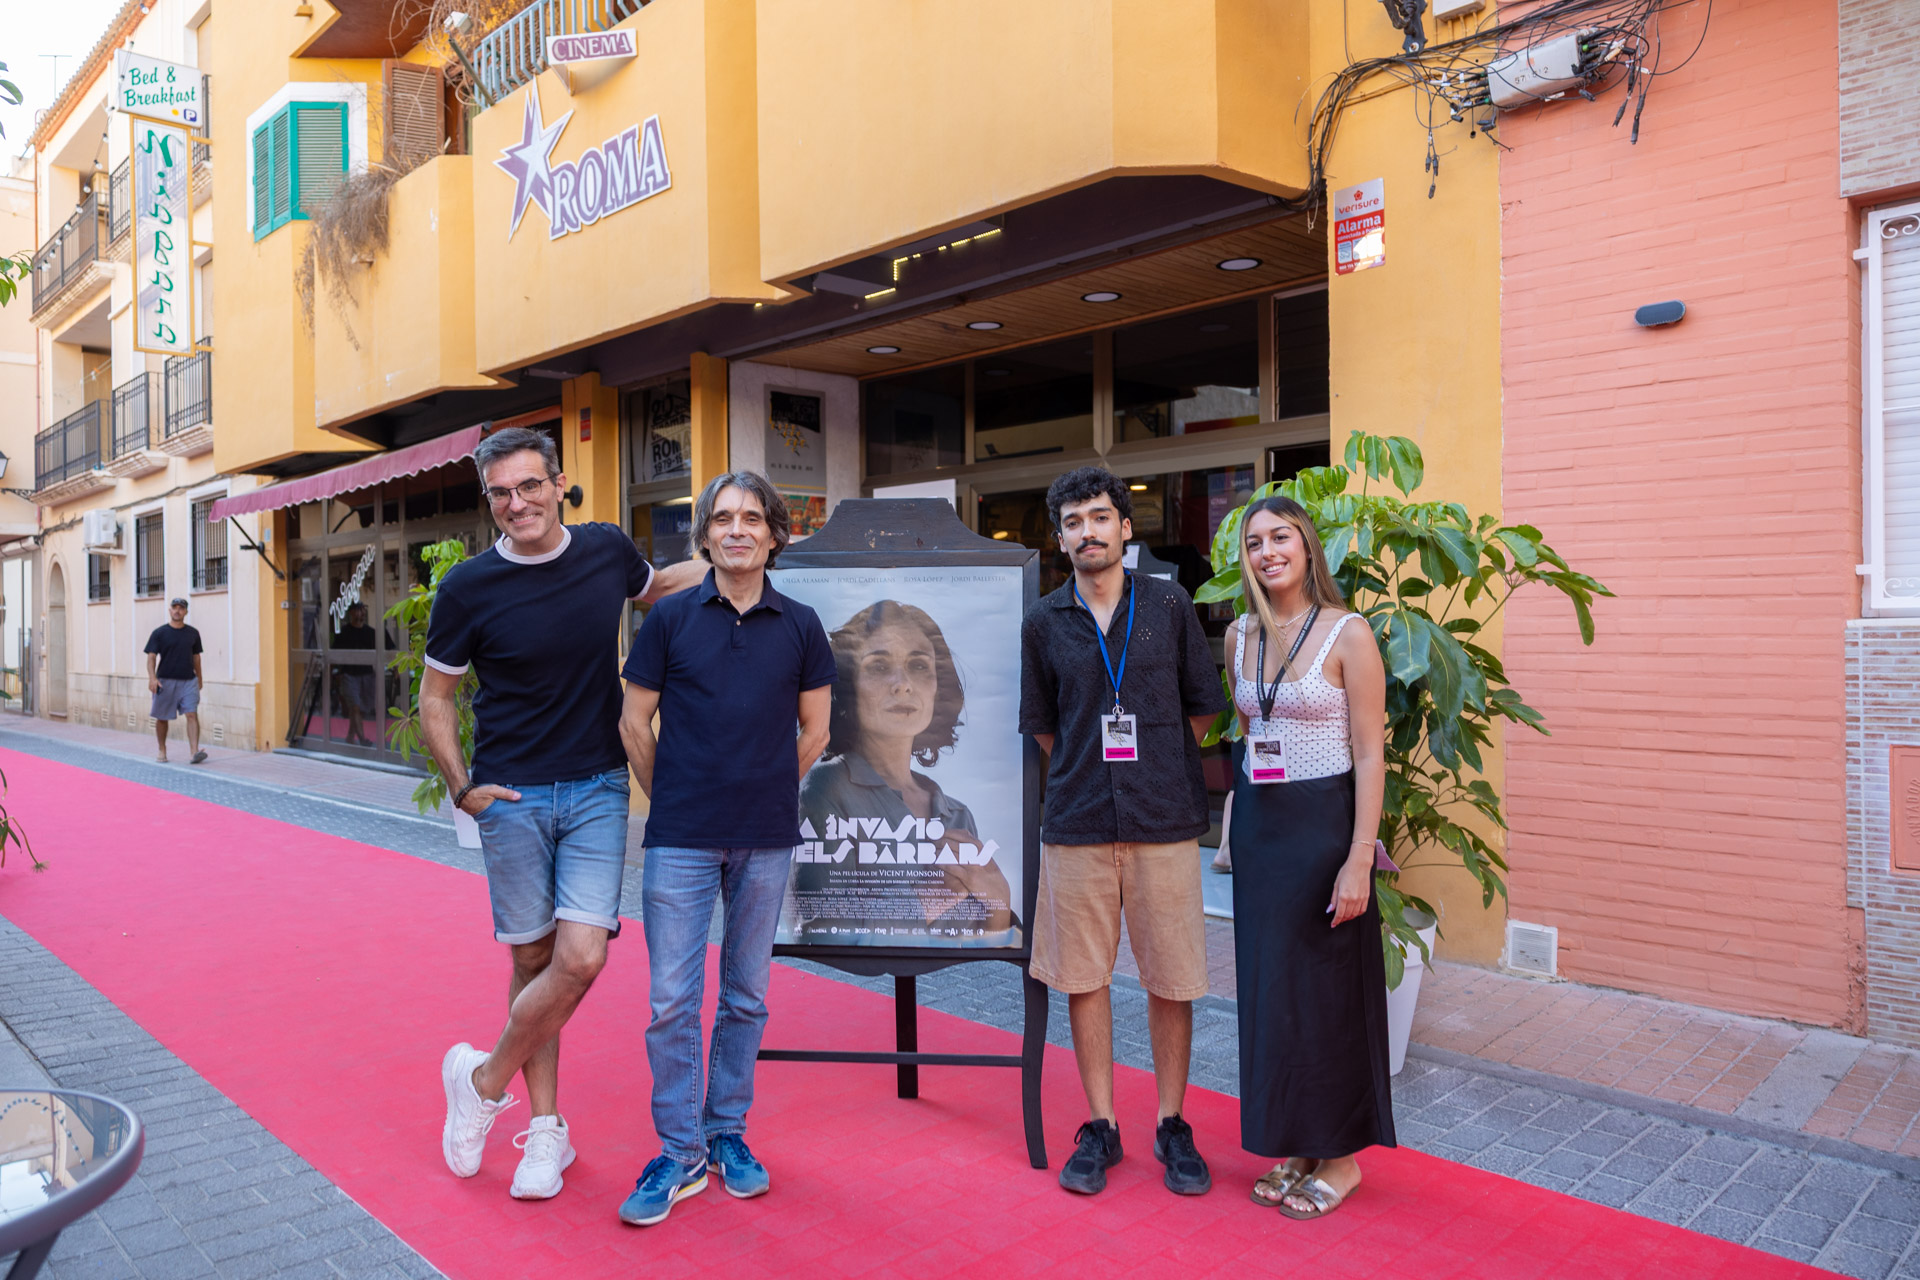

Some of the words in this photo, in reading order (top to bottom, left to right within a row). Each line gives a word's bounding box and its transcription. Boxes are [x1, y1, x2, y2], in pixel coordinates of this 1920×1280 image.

[552, 33, 632, 61] CINEMA
[128, 66, 159, 86] Bed
[166, 66, 176, 83] &
[123, 86, 197, 107] Breakfast
[551, 117, 669, 238] ROMA
[1338, 198, 1380, 214] verisure
[1337, 215, 1382, 235] Alarma
[973, 575, 1007, 583] BALLESTER
[789, 839, 855, 864] ELS
[879, 869, 905, 877] VICENT
[906, 869, 945, 877] MONSONÍS
